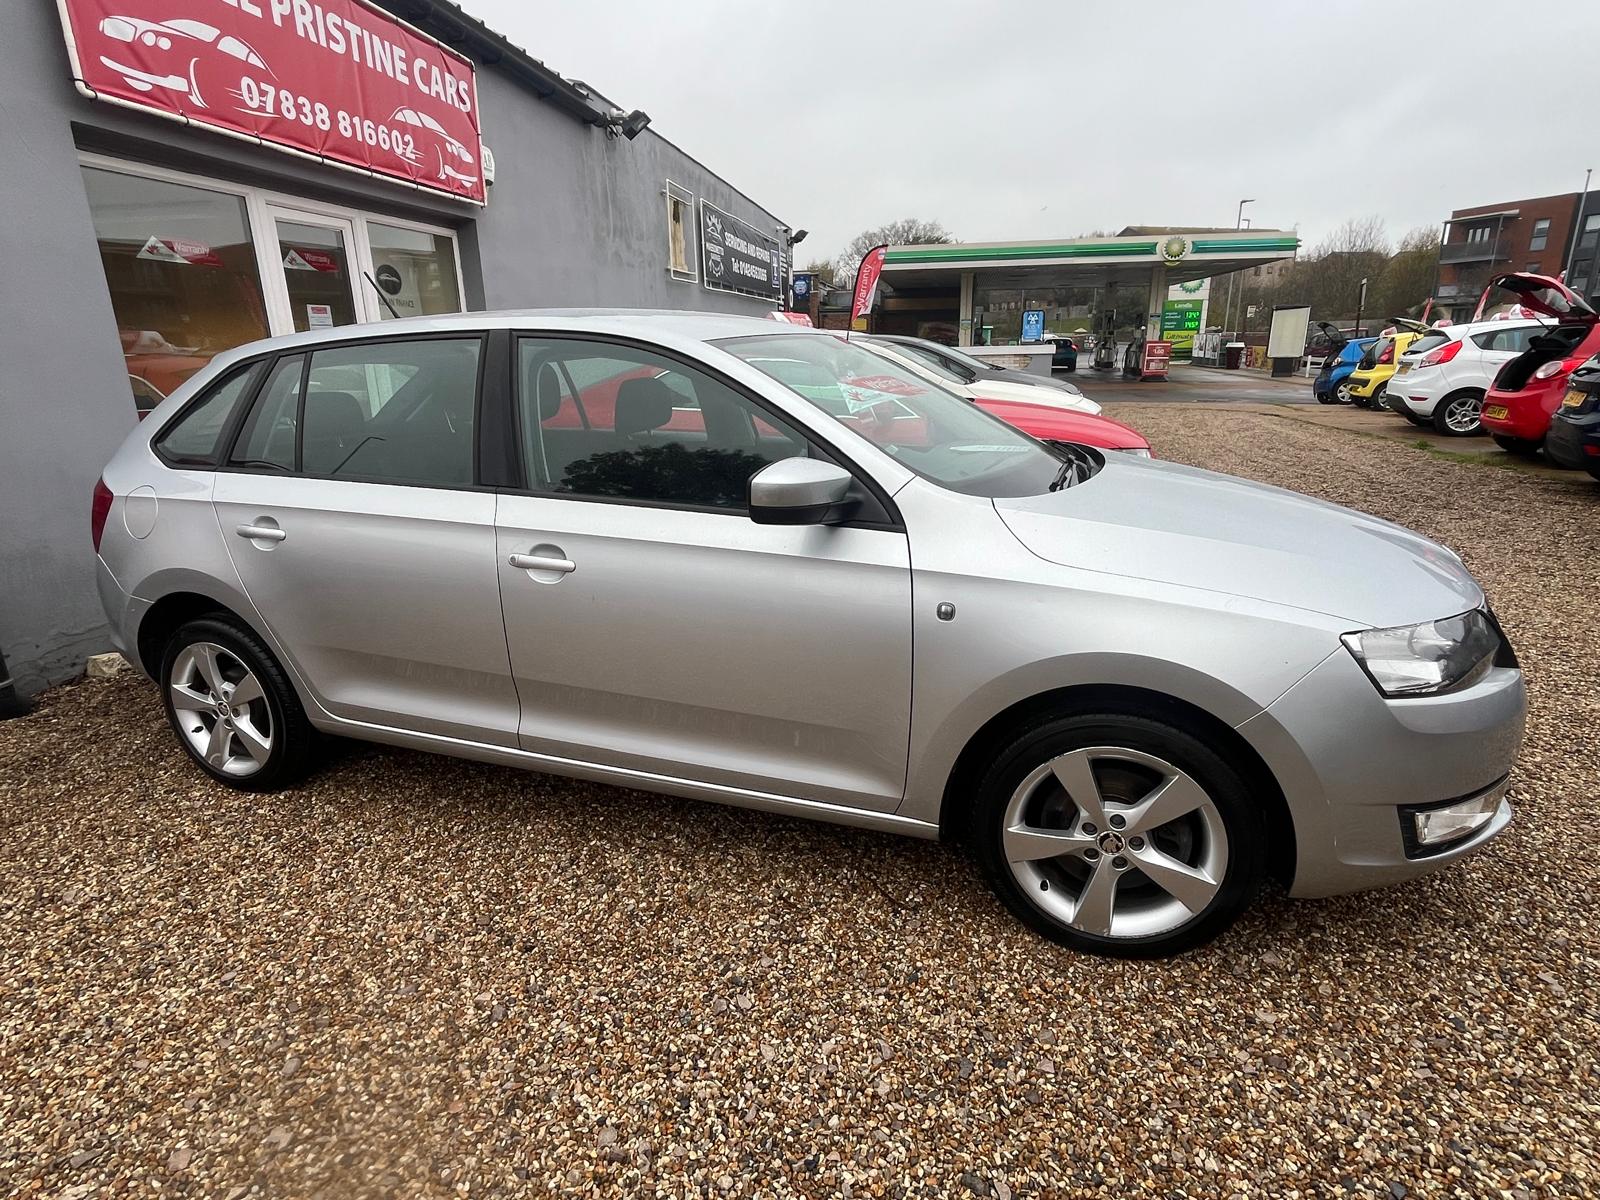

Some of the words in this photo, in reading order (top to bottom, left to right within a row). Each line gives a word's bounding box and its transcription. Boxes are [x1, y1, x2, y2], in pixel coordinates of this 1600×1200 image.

[270, 0, 409, 86] PRISTINE
[413, 58, 471, 113] CARS
[240, 76, 331, 132] 07838
[337, 110, 416, 160] 816602
[856, 263, 873, 310] Warranty
